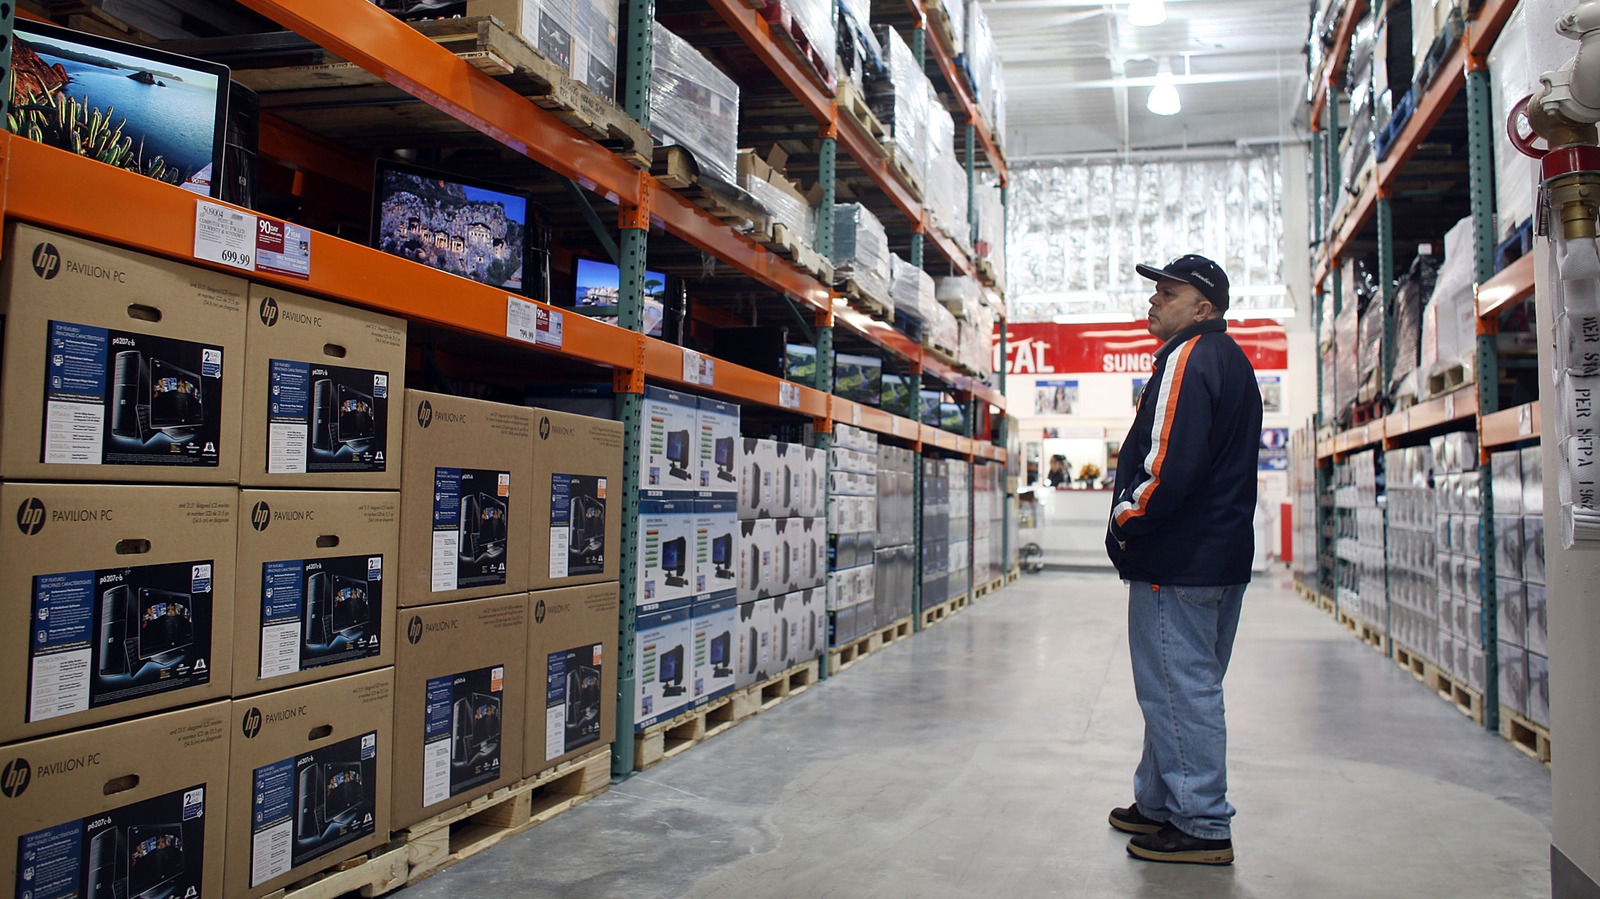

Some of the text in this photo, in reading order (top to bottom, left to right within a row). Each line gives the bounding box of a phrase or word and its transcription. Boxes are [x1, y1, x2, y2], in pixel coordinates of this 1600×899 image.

[203, 206, 224, 218] 509004
[259, 220, 271, 234] 90
[285, 226, 291, 239] 2
[222, 250, 250, 266] 699.99
[66, 260, 126, 284] PAVILION PC
[282, 310, 322, 328] PAVILION PC
[112, 336, 136, 347] p6207c-b
[204, 351, 210, 362] 2
[1102, 352, 1152, 372] SUNG
[375, 376, 380, 385] 2
[1575, 388, 1591, 418] PER
[435, 410, 466, 424] PAVILION PC
[52, 509, 113, 522] PAVILION PC
[274, 510, 314, 521] PAVILION PC
[370, 560, 374, 569] 2
[100, 574, 123, 584] p6207c-b
[194, 567, 200, 578] 2
[425, 620, 458, 632] PAVILION PC
[266, 705, 307, 724] PAVILION PC
[363, 738, 367, 748] 2
[37, 753, 101, 778] PAVILION PC
[185, 794, 192, 805] 2
[87, 816, 112, 832] p6207c-b
